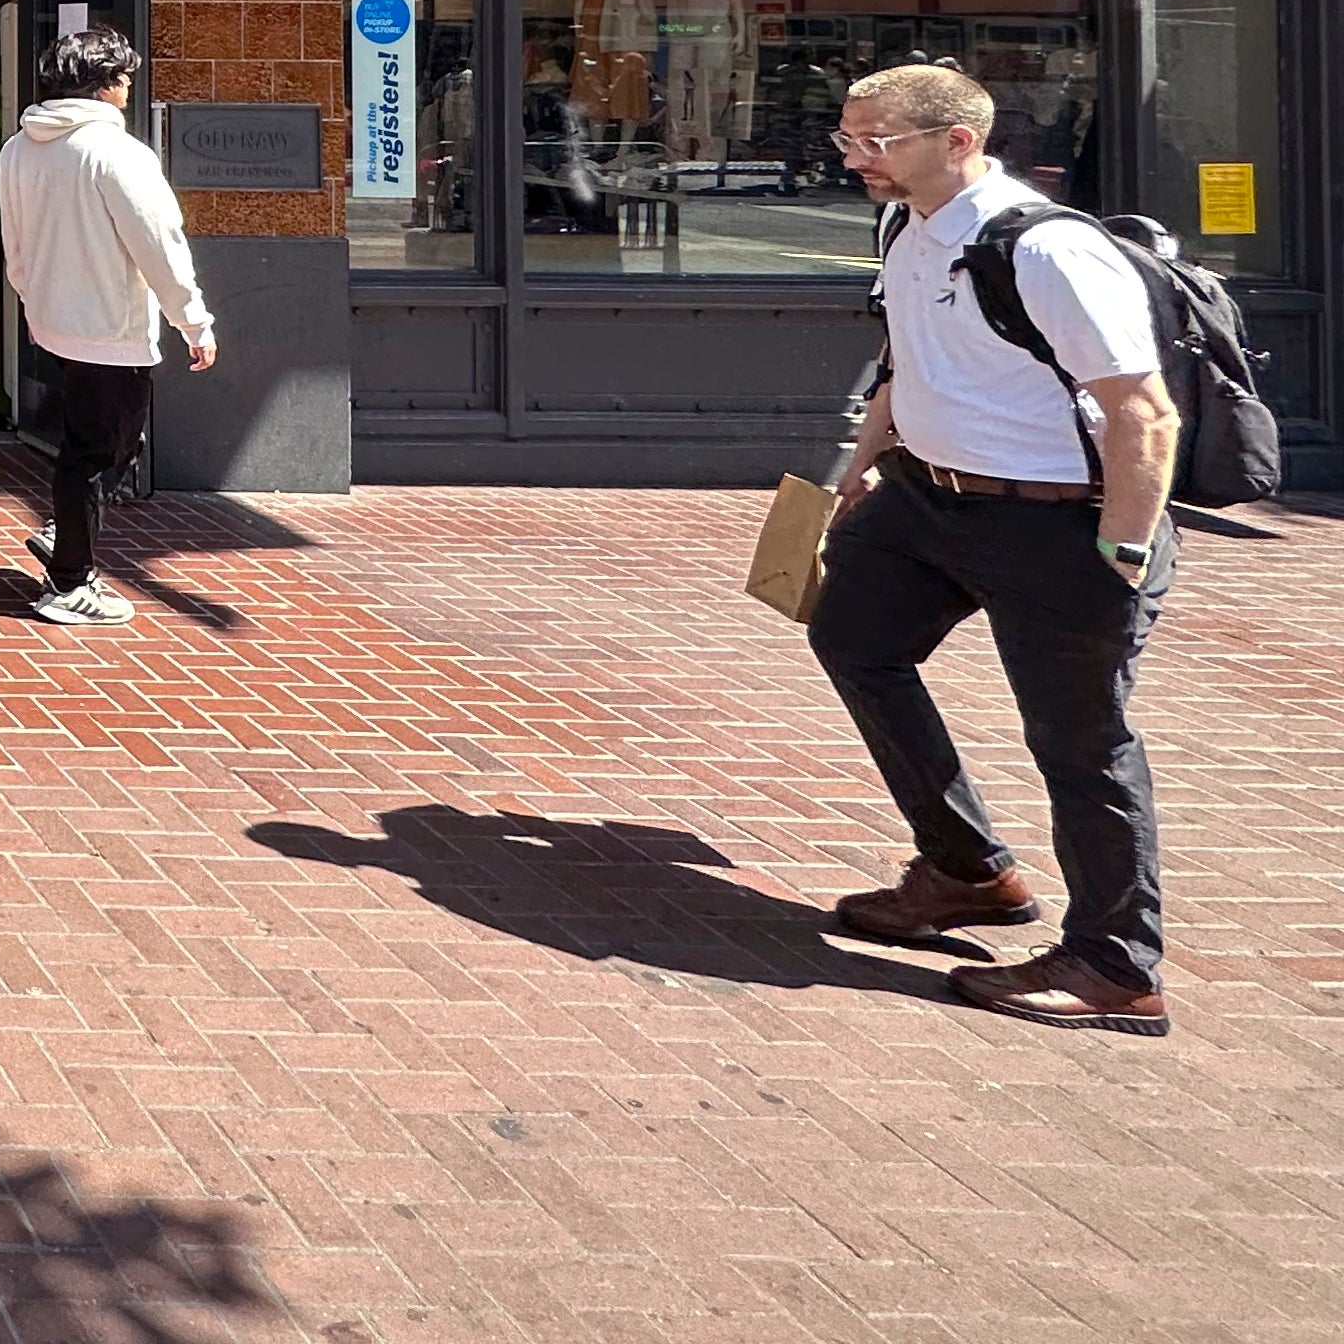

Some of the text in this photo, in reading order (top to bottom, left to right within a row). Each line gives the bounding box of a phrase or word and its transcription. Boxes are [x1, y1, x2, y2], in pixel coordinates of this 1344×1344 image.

[363, 18, 394, 26] PICKUP
[366, 102, 379, 183] Pickup at the
[378, 51, 404, 184] registers!
